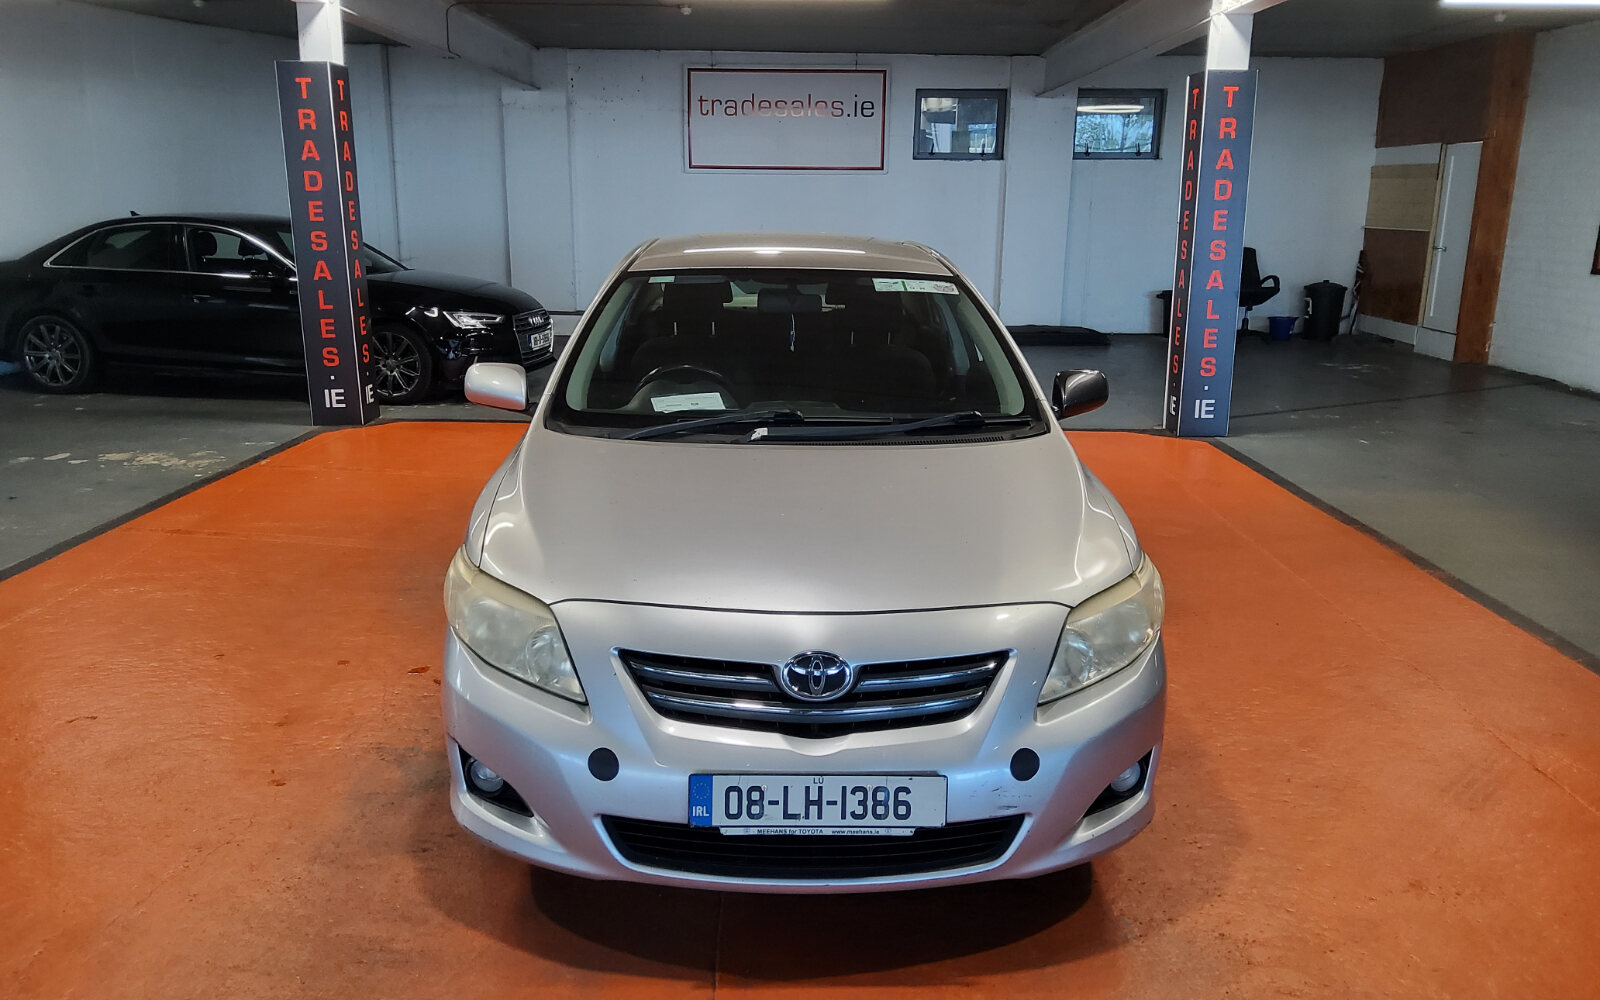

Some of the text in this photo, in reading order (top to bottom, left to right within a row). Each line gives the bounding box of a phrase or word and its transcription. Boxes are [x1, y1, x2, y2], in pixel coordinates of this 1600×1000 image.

[697, 93, 875, 118] tradesales.ie
[692, 805, 710, 817] IRL
[724, 785, 912, 820] 08-LH-1386
